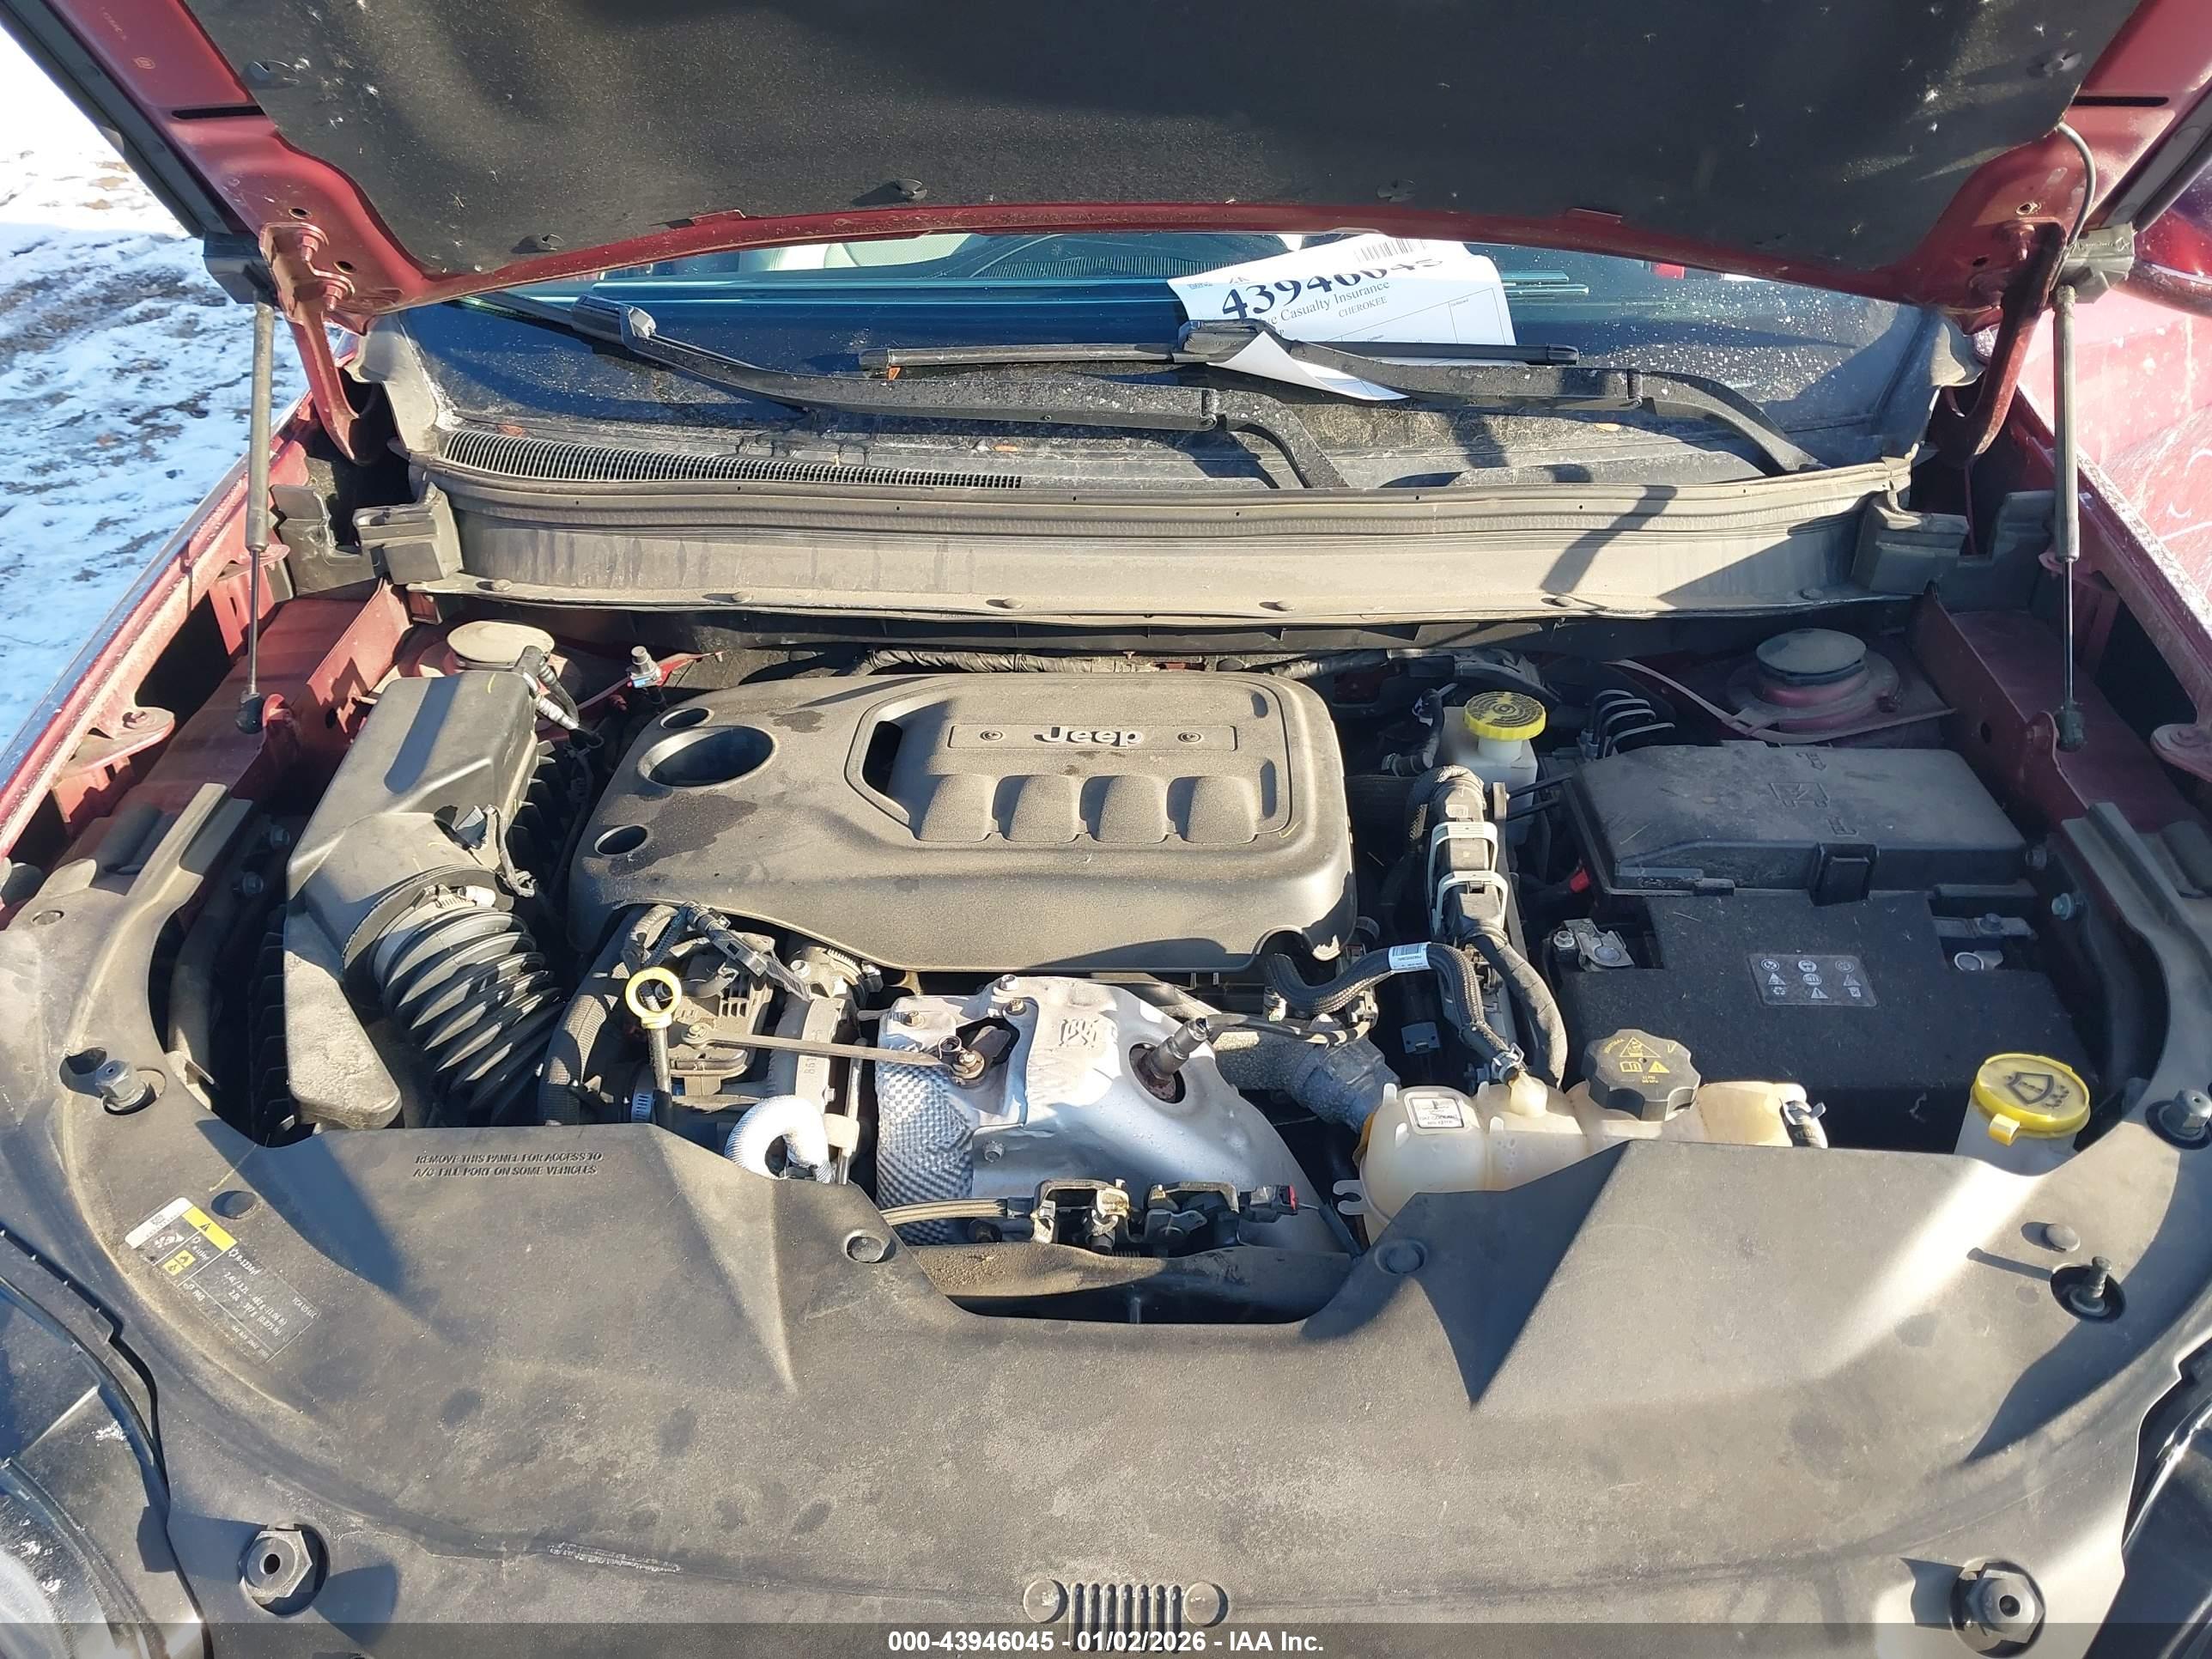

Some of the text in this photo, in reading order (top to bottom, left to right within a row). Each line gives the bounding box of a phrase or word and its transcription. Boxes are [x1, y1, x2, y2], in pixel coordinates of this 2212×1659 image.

[1280, 298, 1331, 322] Casualty
[1334, 281, 1390, 305] Insurance
[1339, 296, 1388, 318] CHEROKEE
[1033, 726, 1144, 747] Jeep
[414, 1152, 604, 1165] REMOVE THIS PANEL FOR ACCESS TO
[412, 1164, 599, 1177] A/C FILL PORT ON SOME VEHICLES
